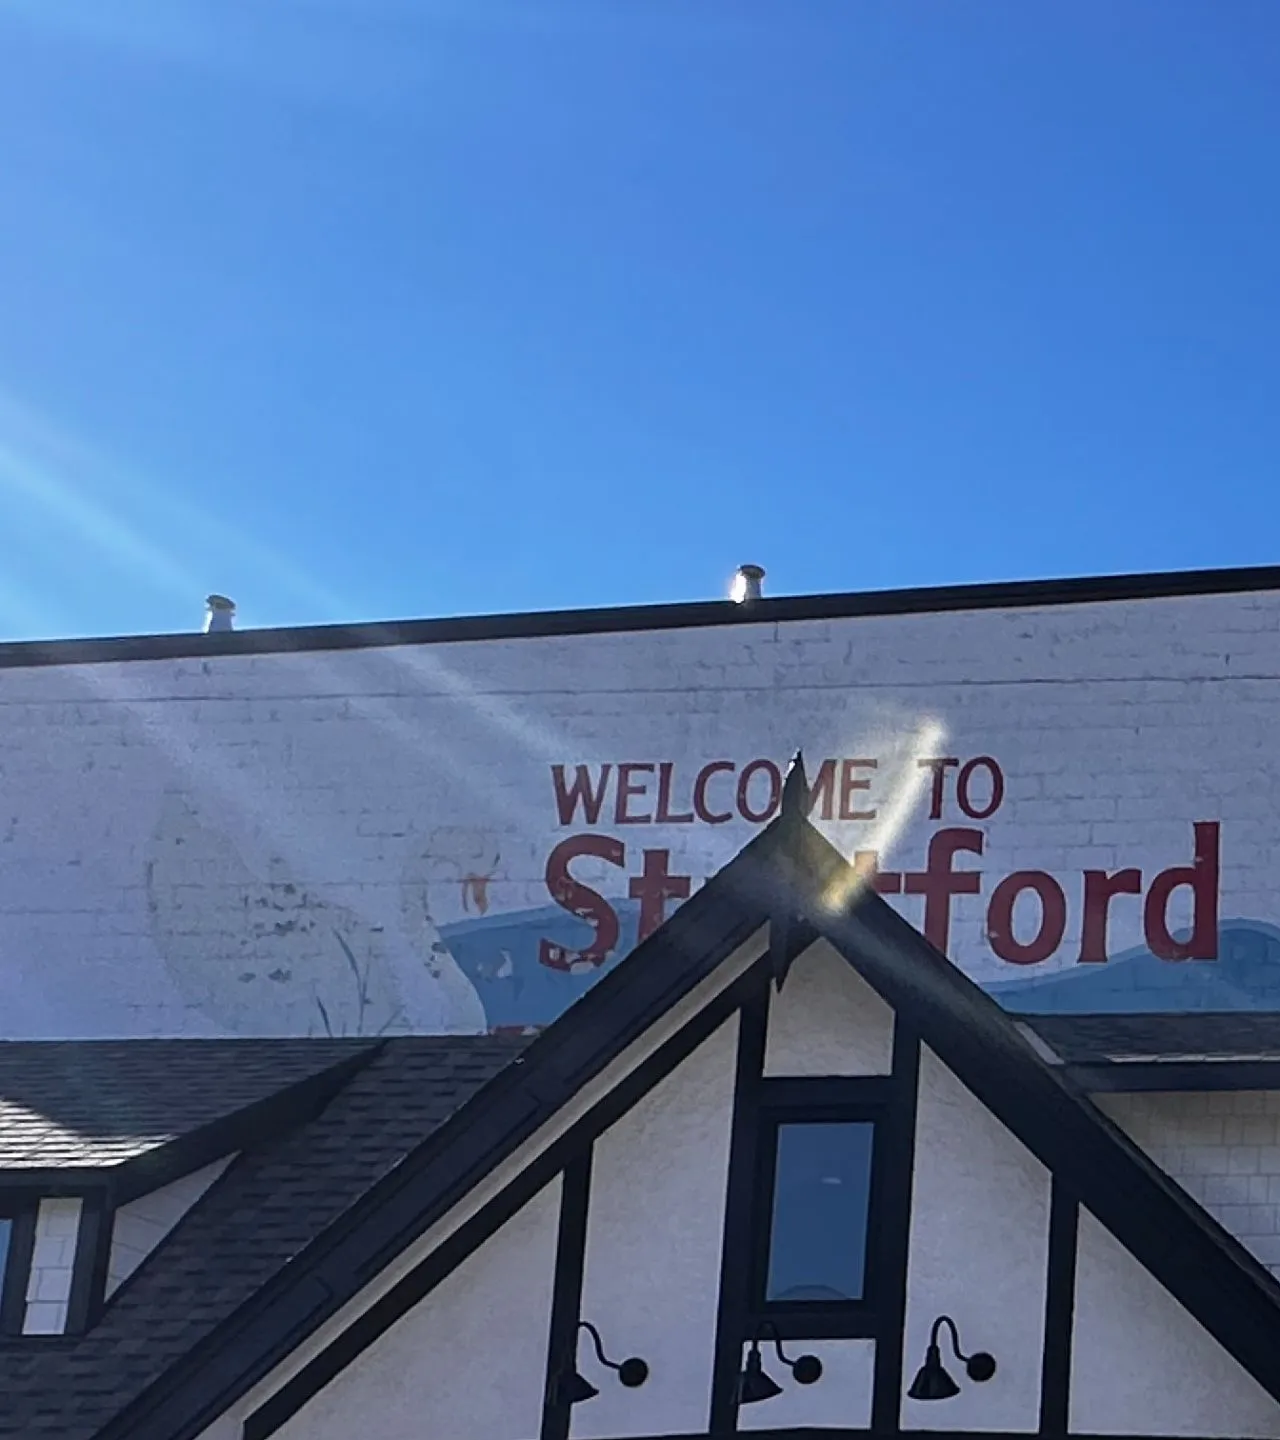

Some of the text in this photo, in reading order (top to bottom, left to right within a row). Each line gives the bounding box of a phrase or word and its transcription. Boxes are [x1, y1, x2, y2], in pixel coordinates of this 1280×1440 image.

[551, 756, 1005, 825] WELCOME TO
[538, 821, 1221, 974] Stford
